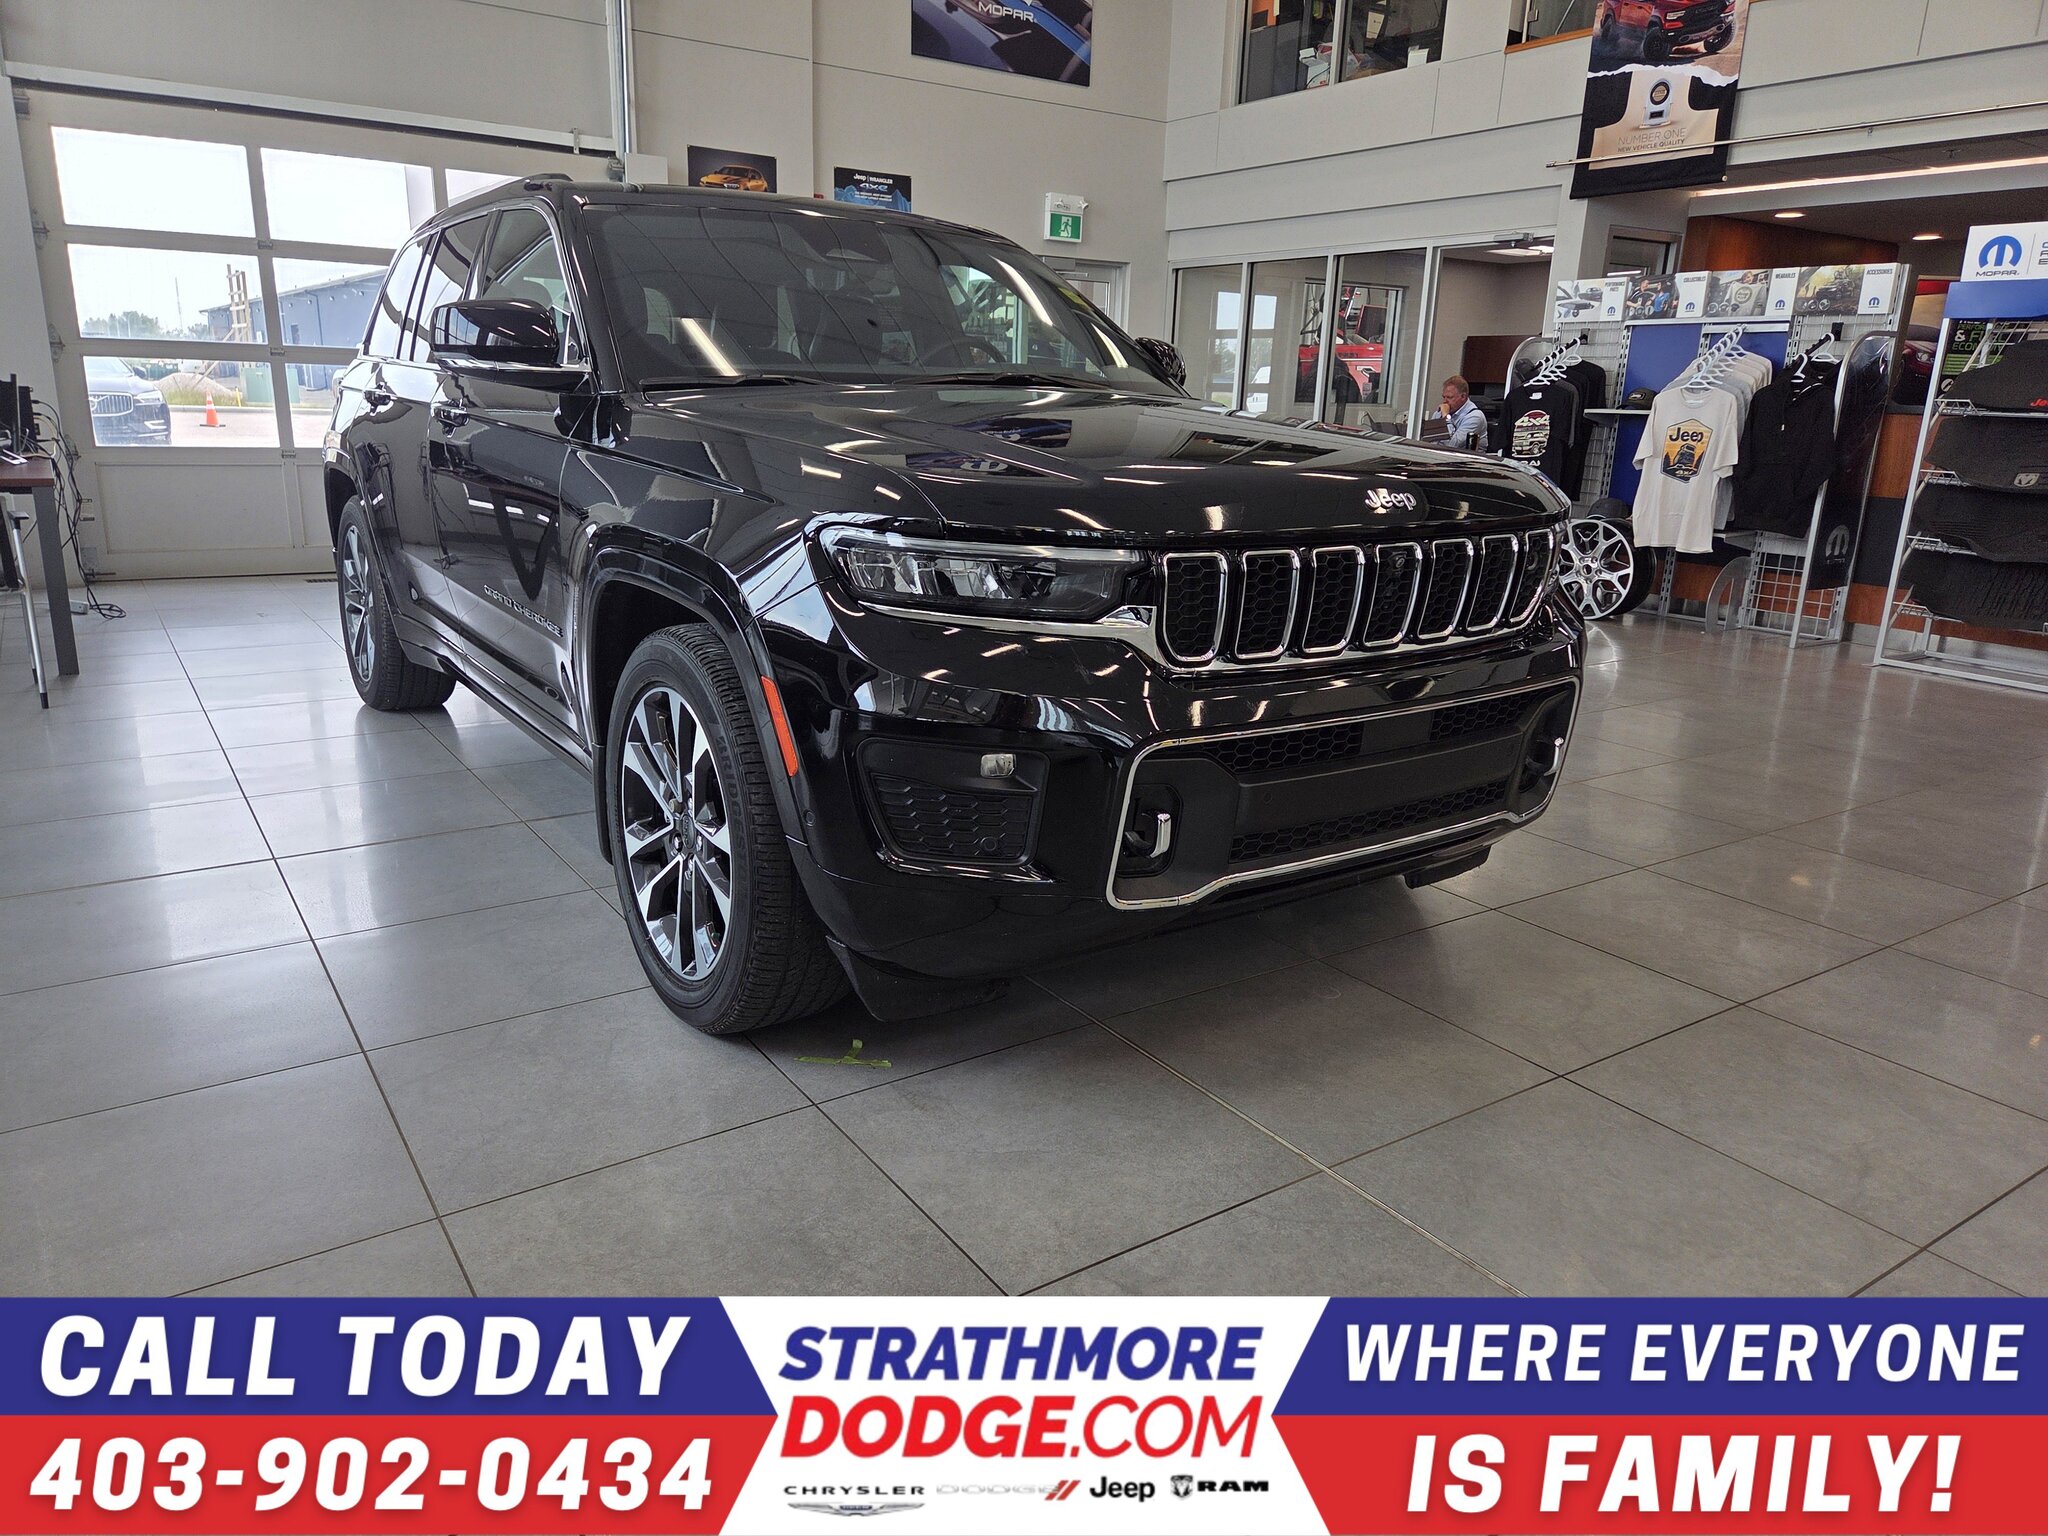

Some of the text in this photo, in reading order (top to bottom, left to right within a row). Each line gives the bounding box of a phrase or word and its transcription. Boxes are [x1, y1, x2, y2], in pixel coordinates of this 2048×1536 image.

[978, 1, 1034, 23] MOPAR
[1618, 127, 1687, 146] NUMBER ONE
[1633, 143, 1657, 151] VEHICLE
[1658, 138, 1686, 147] QUALITY
[853, 173, 893, 185] Jeep WRANGLER
[1975, 269, 2020, 278] MOPAR
[1954, 329, 1966, 341] &
[1515, 415, 1550, 426] 4x4
[1669, 427, 1704, 442] Jeep
[1364, 489, 1417, 511] Jeep
